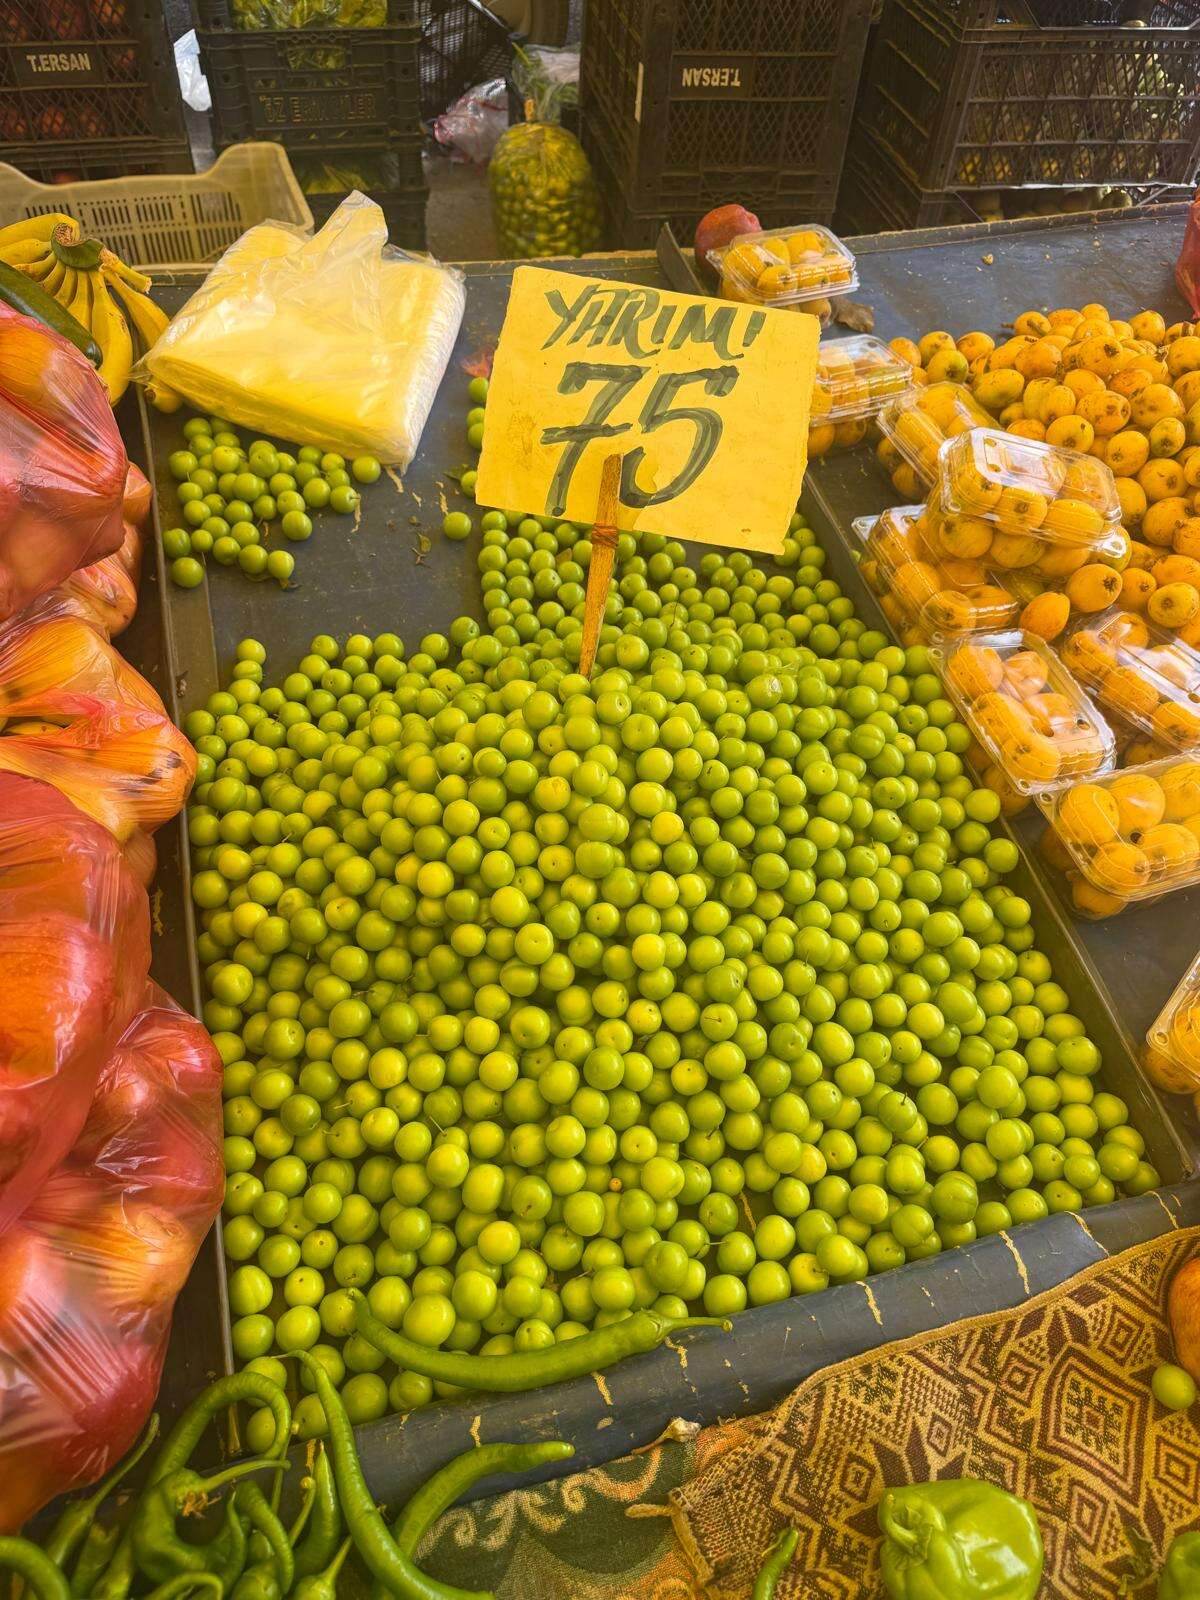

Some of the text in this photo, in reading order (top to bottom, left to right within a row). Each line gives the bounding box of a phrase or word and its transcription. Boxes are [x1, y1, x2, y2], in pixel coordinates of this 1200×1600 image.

[26, 53, 92, 72] T.ERSAN
[681, 67, 742, 87] T.ERSAN
[541, 361, 740, 517] 75
